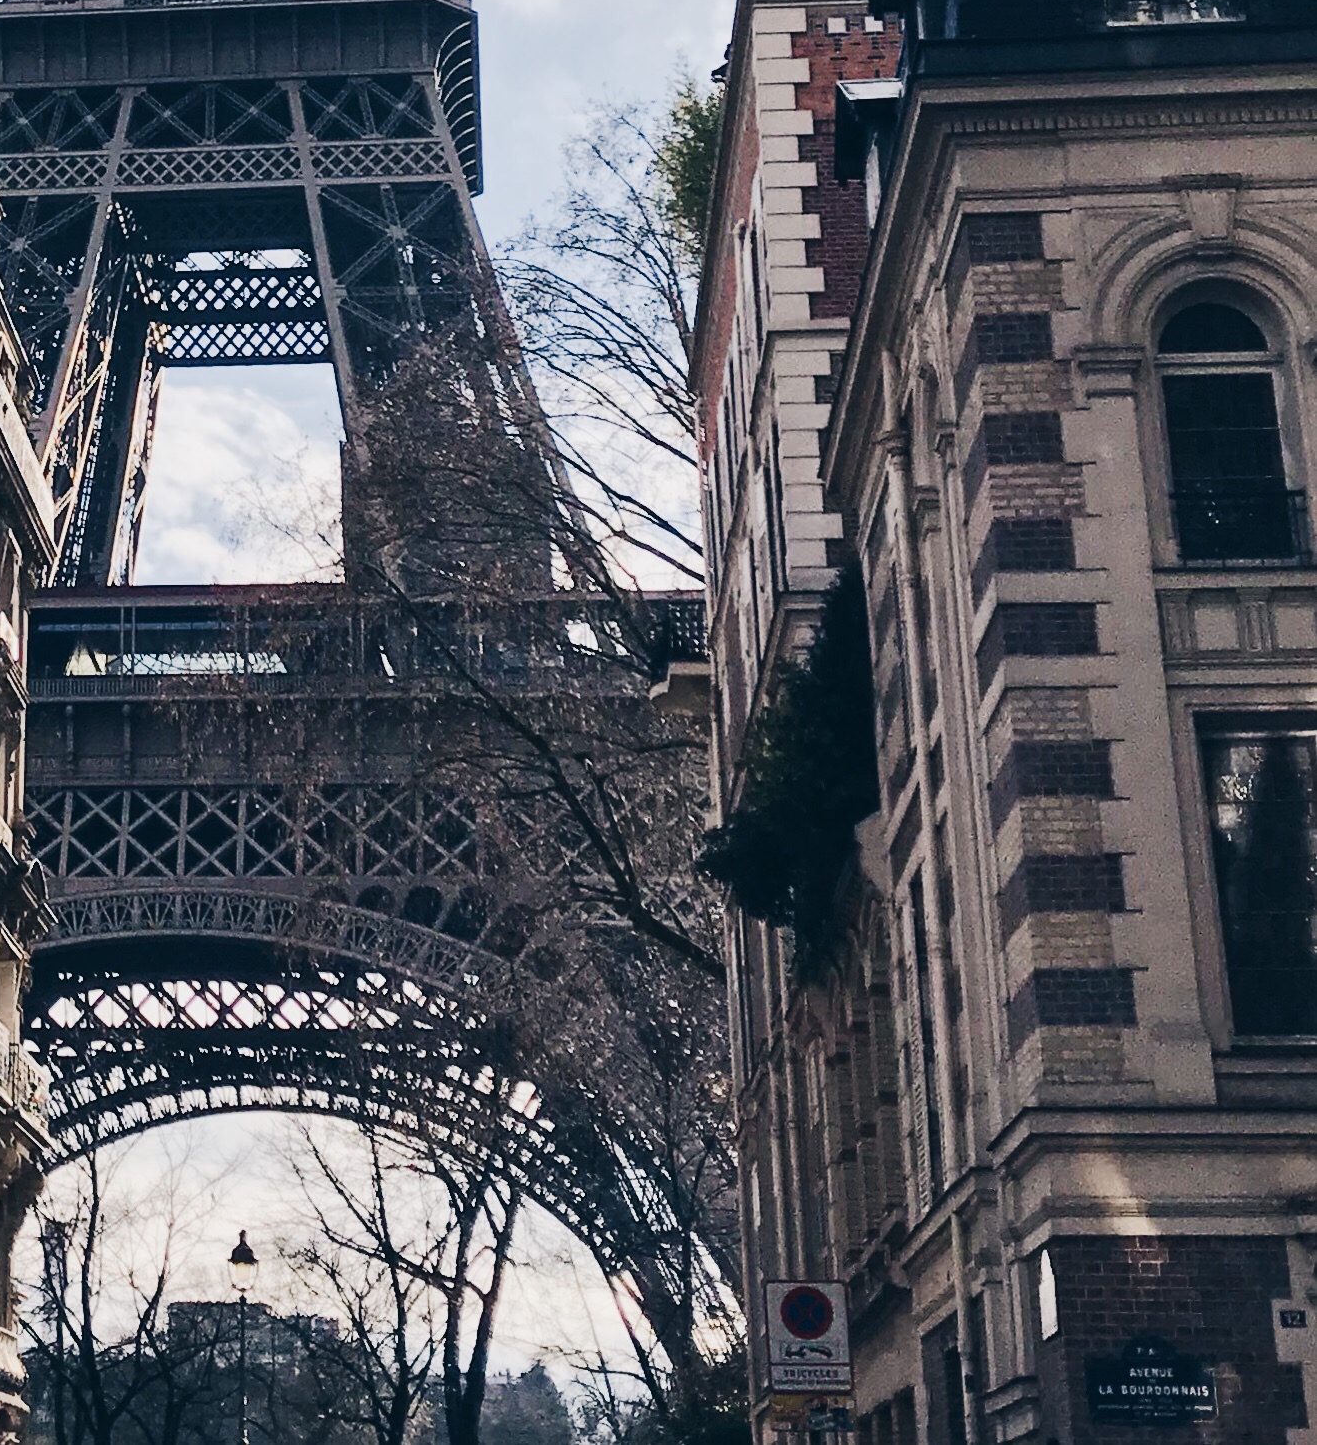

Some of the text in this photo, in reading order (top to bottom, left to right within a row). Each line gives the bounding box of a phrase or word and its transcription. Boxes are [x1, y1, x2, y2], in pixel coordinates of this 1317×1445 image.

[784, 1369, 838, 1378] TRICYCLES
[1129, 1367, 1174, 1377] AVENUE
[1098, 1385, 1209, 1397] LA BOURDONNAIS
